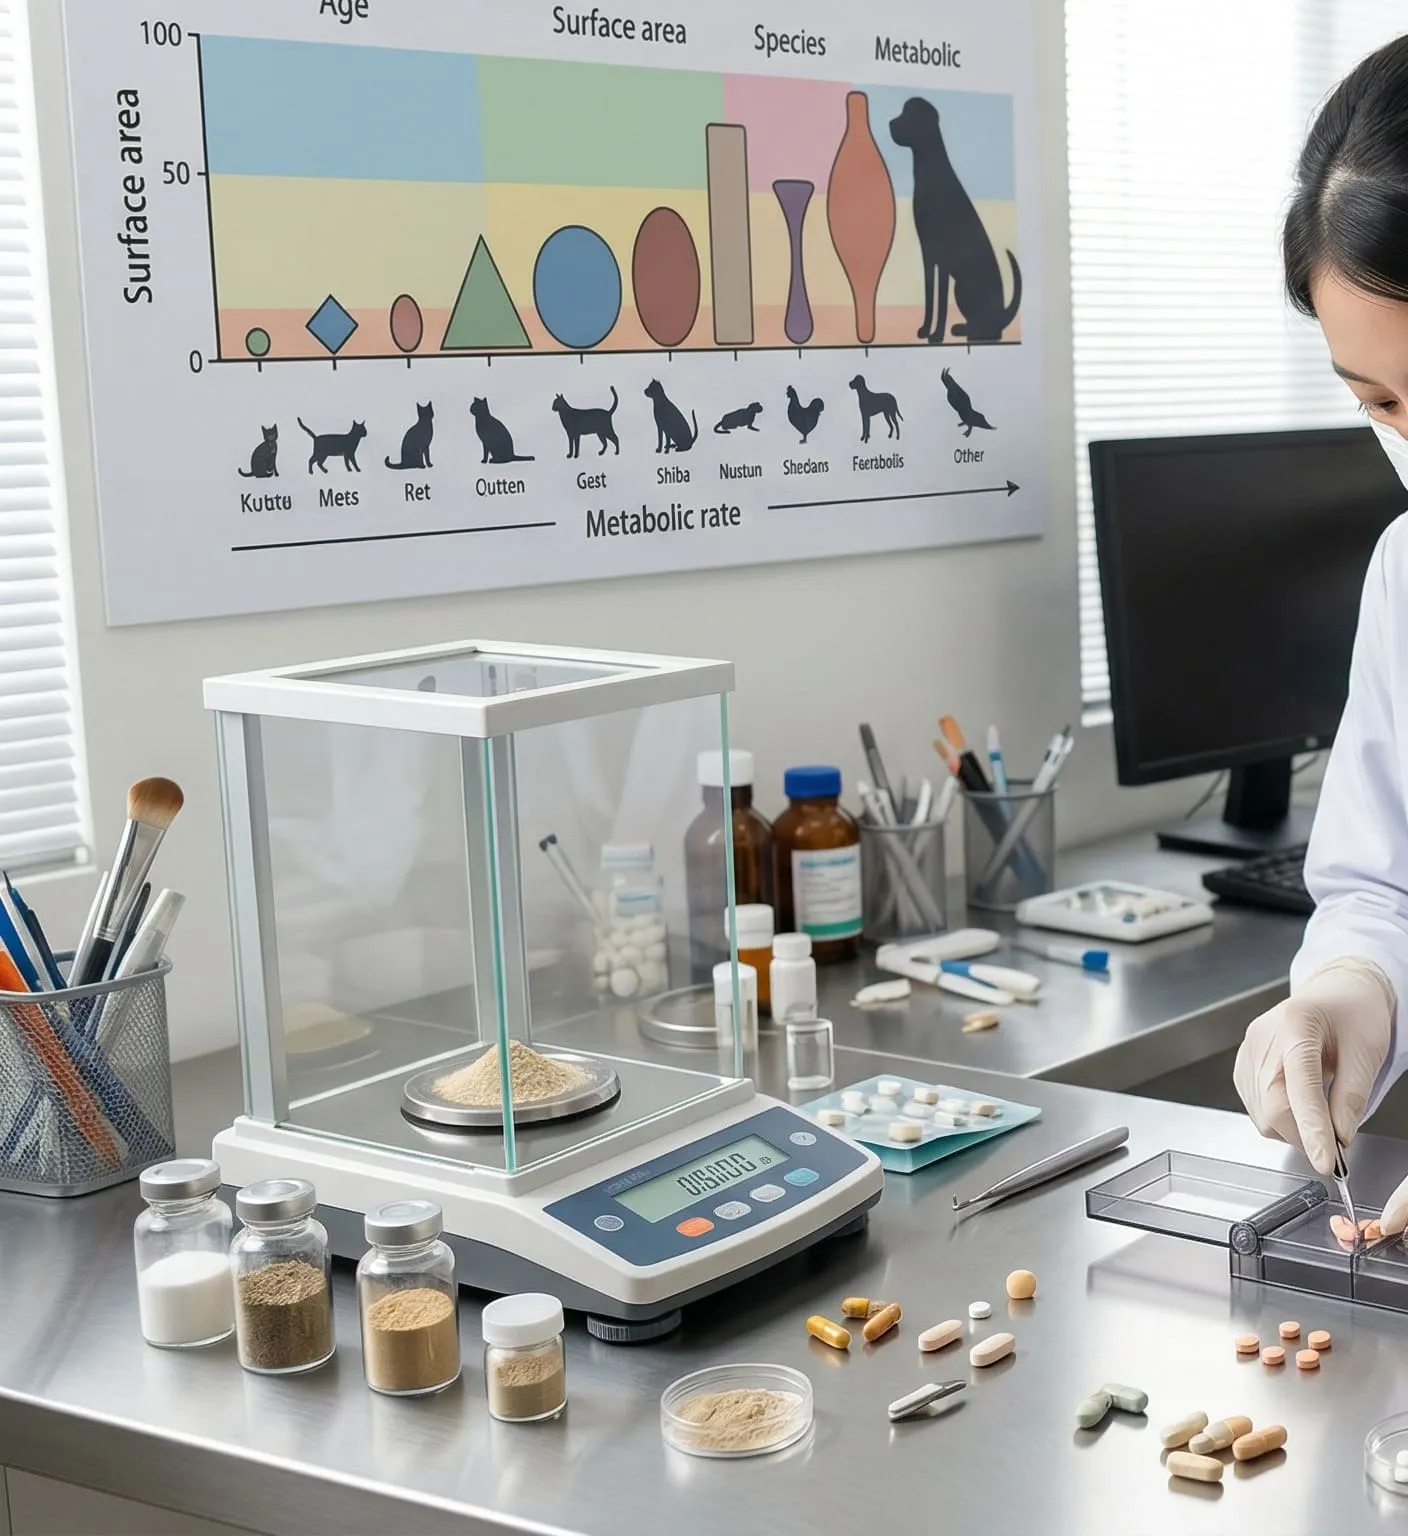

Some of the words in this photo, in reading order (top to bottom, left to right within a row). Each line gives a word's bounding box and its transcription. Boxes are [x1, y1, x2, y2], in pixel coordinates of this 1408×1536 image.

[319, 0, 369, 25] Age
[553, 5, 636, 40] Surface
[641, 20, 687, 44] area
[140, 20, 182, 47] 100
[754, 24, 826, 58] Species
[875, 36, 961, 68] Metabolic
[116, 89, 143, 164] area
[163, 160, 190, 185] 50
[117, 184, 153, 304] Surface
[189, 350, 203, 374] 0
[953, 448, 985, 464] Other
[576, 472, 607, 490] Gest
[656, 465, 690, 485] Shiba
[719, 463, 762, 480] Nustun
[404, 483, 431, 502] Ret
[475, 478, 525, 497] Outten
[586, 503, 695, 538] Metabolic
[700, 503, 741, 529] rate
